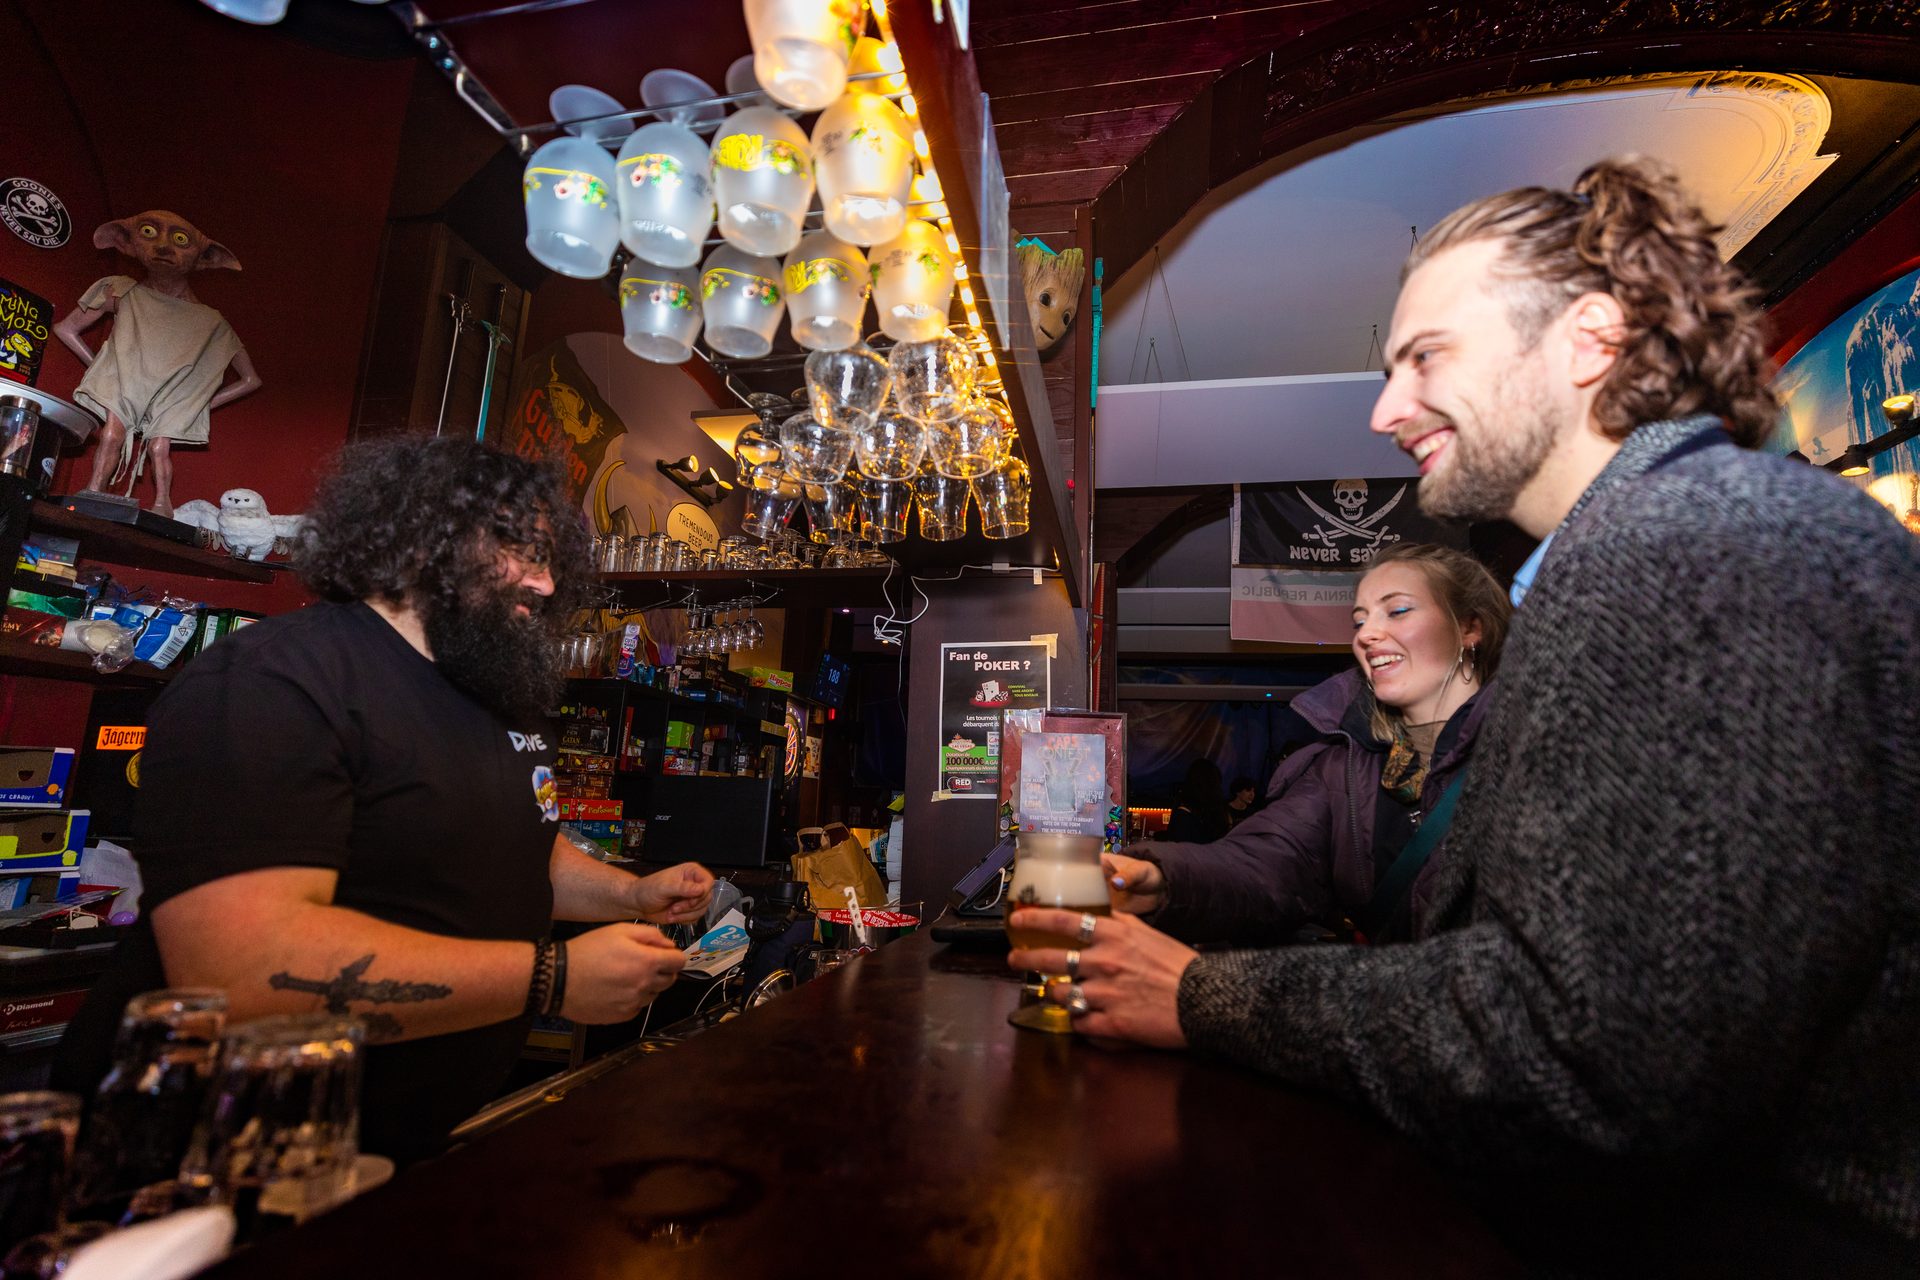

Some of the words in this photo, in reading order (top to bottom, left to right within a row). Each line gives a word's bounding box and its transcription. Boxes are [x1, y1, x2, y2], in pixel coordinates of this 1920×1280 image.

[12, 180, 61, 210] GOONIES
[0, 205, 22, 233] NEVER
[22, 231, 41, 244] SAY
[42, 236, 60, 246] DIE!
[678, 512, 713, 544] TREMENDOUS
[688, 532, 703, 550] BEER
[949, 651, 970, 661] Fan
[973, 650, 988, 660] de
[974, 660, 1020, 671] POKER
[1023, 660, 1031, 670] ?
[962, 721, 994, 729] débarquent
[1047, 735, 1078, 750] CAPS
[1036, 746, 1091, 760] CONTEST
[945, 757, 962, 765] 100
[963, 757, 985, 765] 000€
[16, 999, 54, 1011] Diamond
